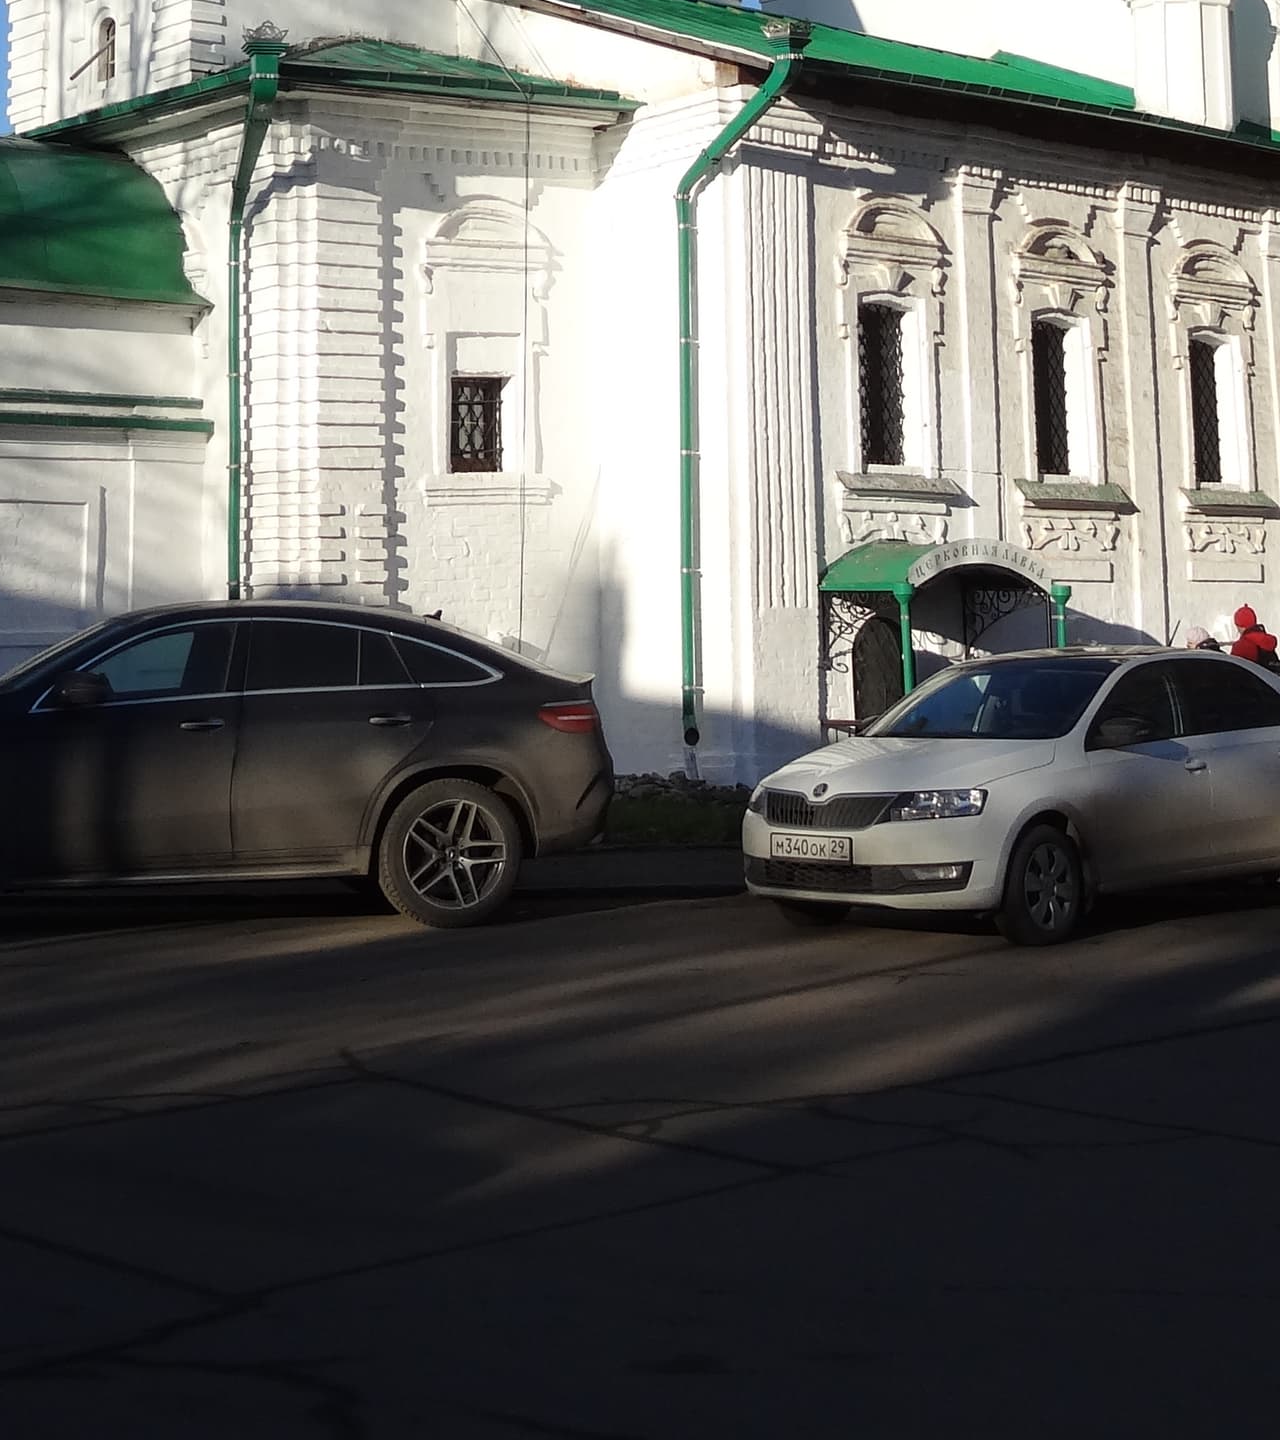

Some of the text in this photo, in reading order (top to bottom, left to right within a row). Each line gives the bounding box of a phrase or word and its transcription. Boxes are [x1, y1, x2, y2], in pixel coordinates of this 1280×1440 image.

[915, 545, 1046, 580] ЦЕРКОВНАЯ ЛАВКА
[775, 837, 845, 857] М340ОК 29
